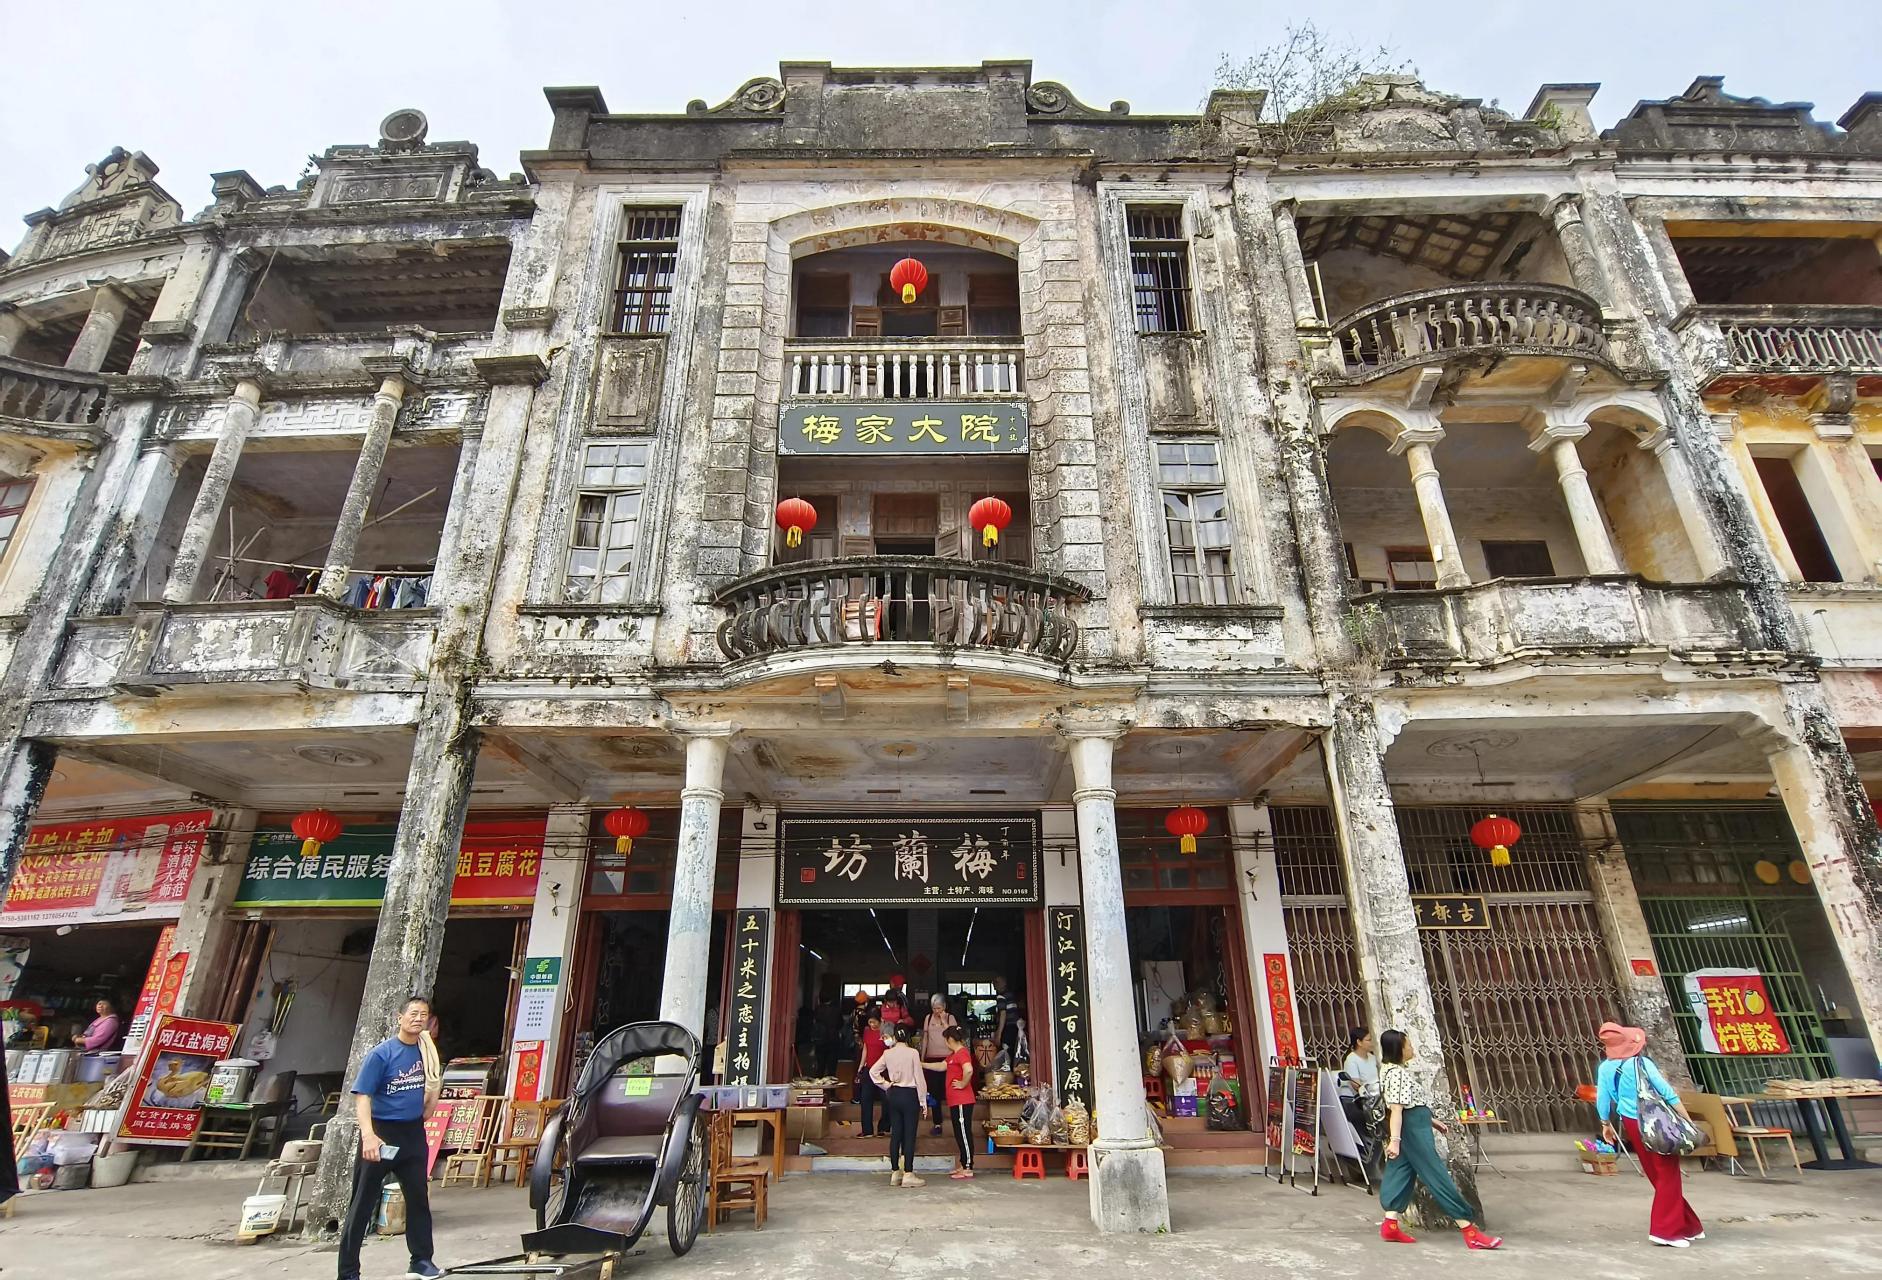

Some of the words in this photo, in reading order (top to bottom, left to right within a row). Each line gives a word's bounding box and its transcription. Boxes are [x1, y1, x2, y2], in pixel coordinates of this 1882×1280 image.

[801, 414, 1001, 444] 梅家大院
[246, 854, 394, 880] 综合便民服务
[1703, 987, 1745, 1015] 手打
[158, 1029, 229, 1052] 网红盐焗鸡
[1716, 1022, 1780, 1052] 柠檬茶
[131, 1120, 192, 1131] 网红盐焗鸡
